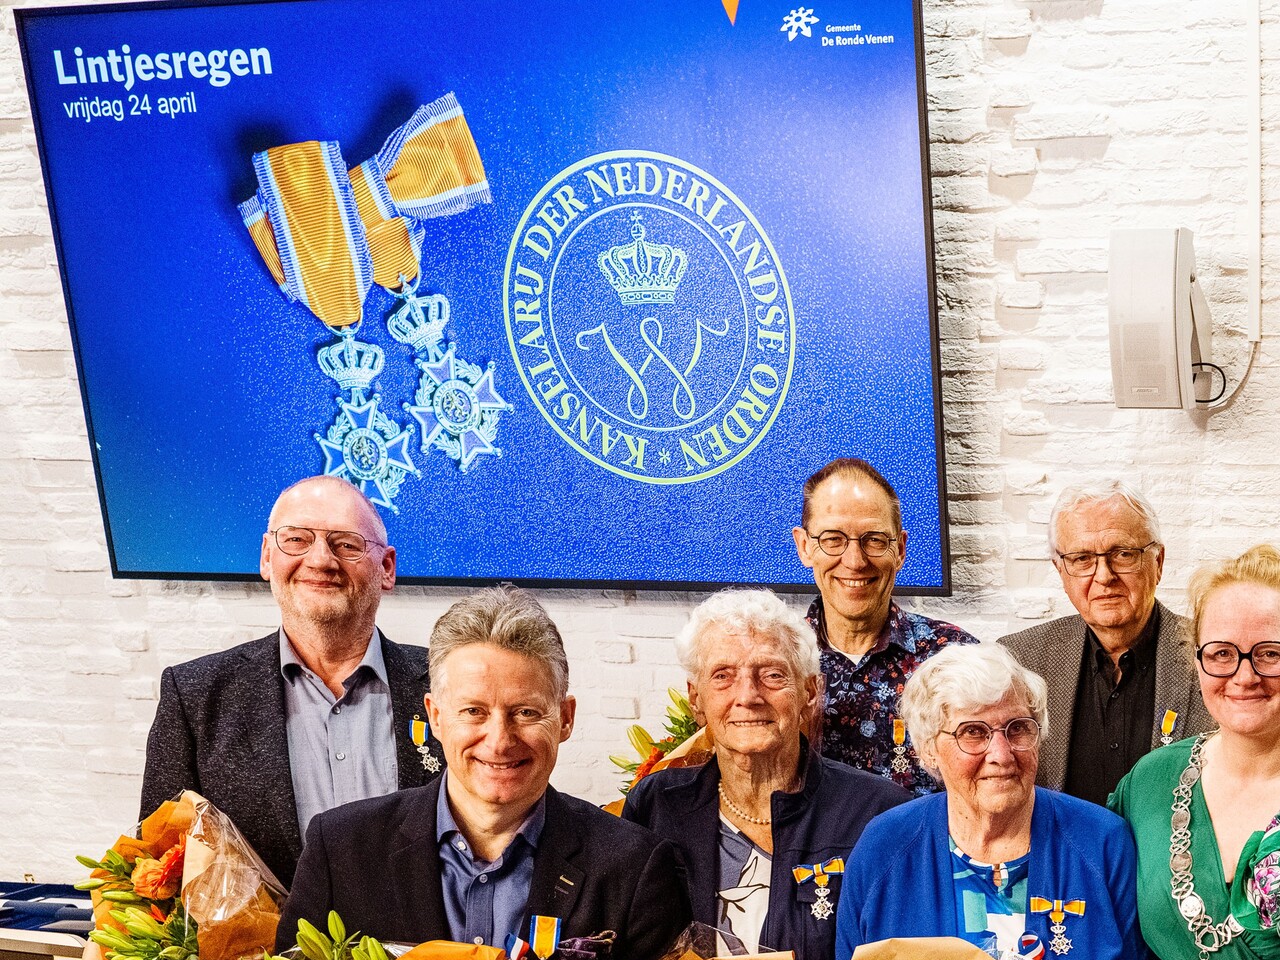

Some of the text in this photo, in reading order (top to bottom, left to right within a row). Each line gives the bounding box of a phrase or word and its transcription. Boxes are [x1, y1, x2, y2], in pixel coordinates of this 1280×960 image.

[821, 34, 894, 46] De Ronde Venen
[826, 24, 861, 33] Gemeente
[53, 44, 273, 91] Lintjesregen
[63, 91, 197, 123] vrijdag 24 april
[523, 184, 588, 262] DER
[584, 162, 787, 354] NEDERLANDSE
[679, 362, 780, 471] ORDEN
